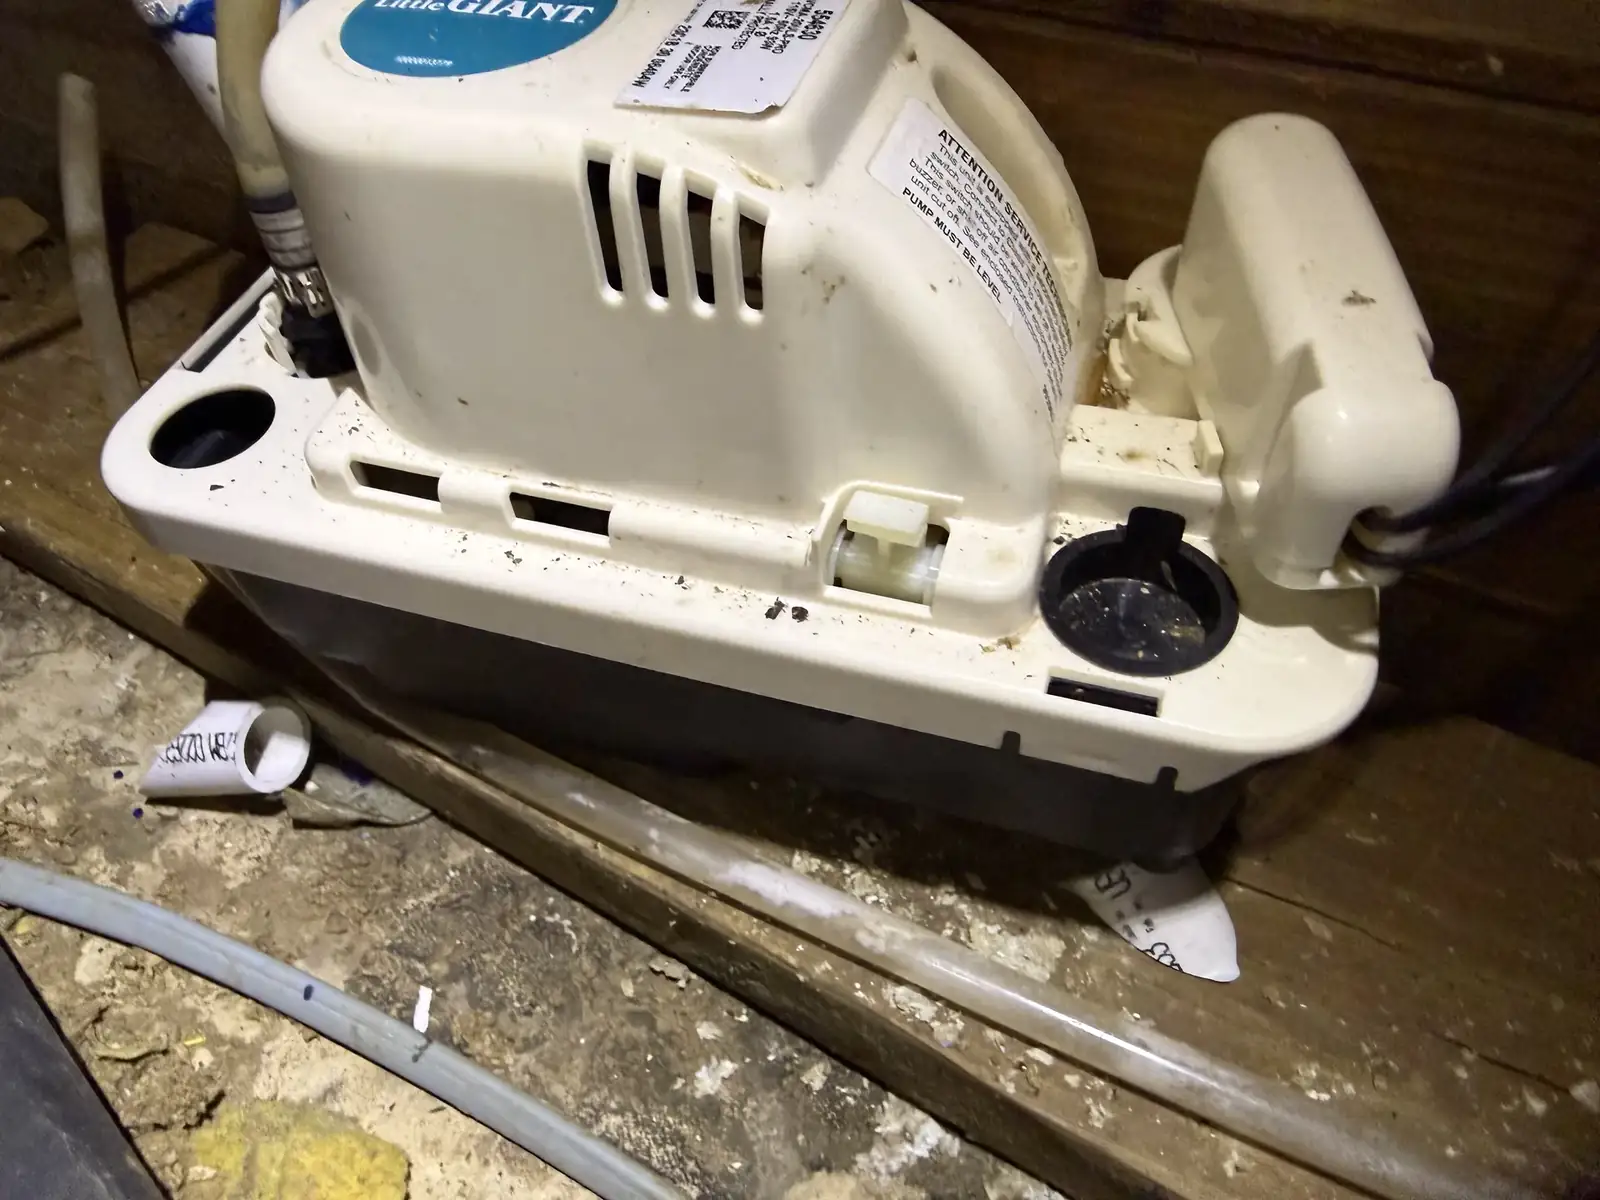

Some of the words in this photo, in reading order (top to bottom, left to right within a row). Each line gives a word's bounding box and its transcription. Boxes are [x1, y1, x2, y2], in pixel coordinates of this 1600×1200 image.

[375, 0, 442, 11] Little
[446, 0, 595, 24] GIANT
[938, 129, 1003, 204] ATTENTION
[1004, 202, 1043, 266] SERVICE
[940, 142, 957, 167] This
[959, 166, 976, 186] unit
[925, 155, 944, 181] This
[945, 179, 973, 211] switch
[974, 209, 1001, 245] should
[945, 193, 957, 205] or
[963, 183, 998, 227] Connect
[902, 186, 934, 217] PUMP
[933, 216, 964, 249] MUST
[962, 246, 978, 269] BE
[976, 264, 1002, 305] LEVEL
[910, 175, 930, 196] unit
[930, 193, 946, 212] cut
[962, 225, 980, 249] See
[980, 248, 1013, 295] enclosed
